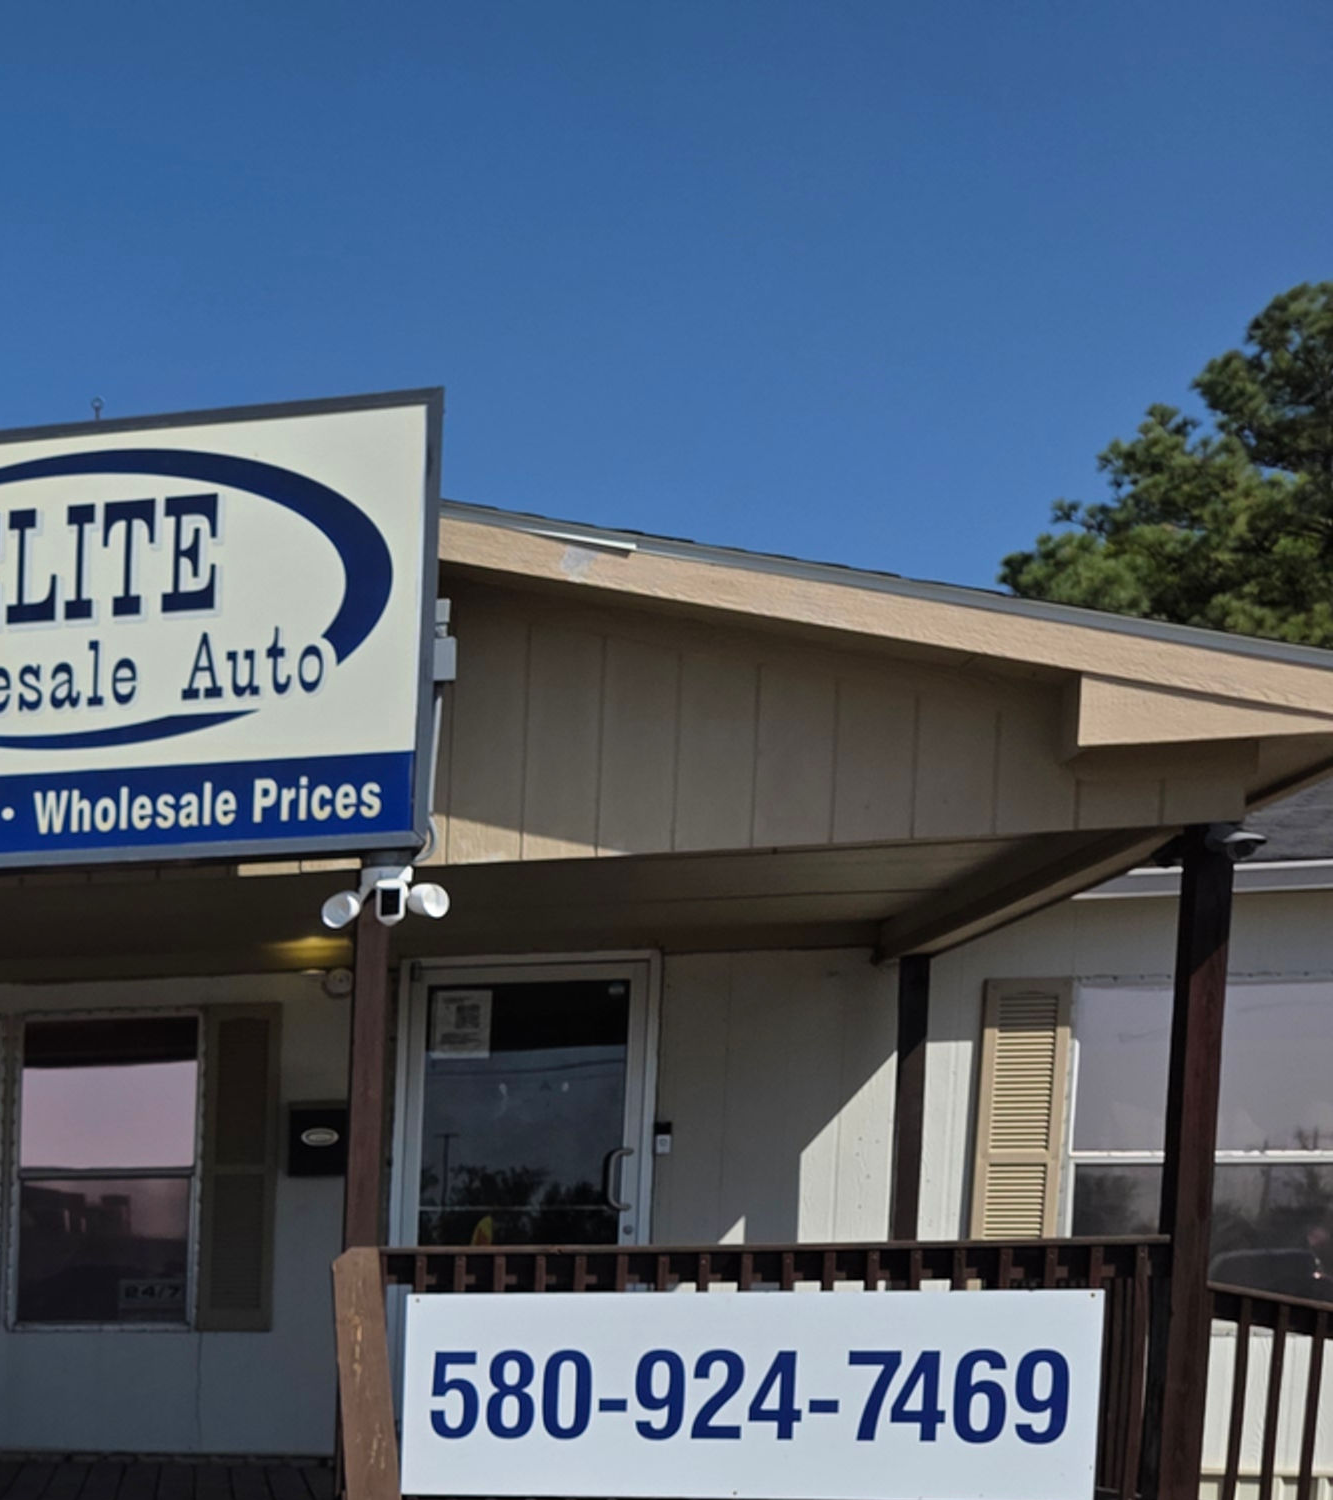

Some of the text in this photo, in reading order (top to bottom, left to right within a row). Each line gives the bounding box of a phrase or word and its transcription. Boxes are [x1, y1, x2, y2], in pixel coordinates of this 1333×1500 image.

[181, 625, 325, 700] Auto
[33, 780, 237, 834] Wholesale
[251, 776, 382, 824] Prices
[429, 1348, 1071, 1445] 580-924-7469
